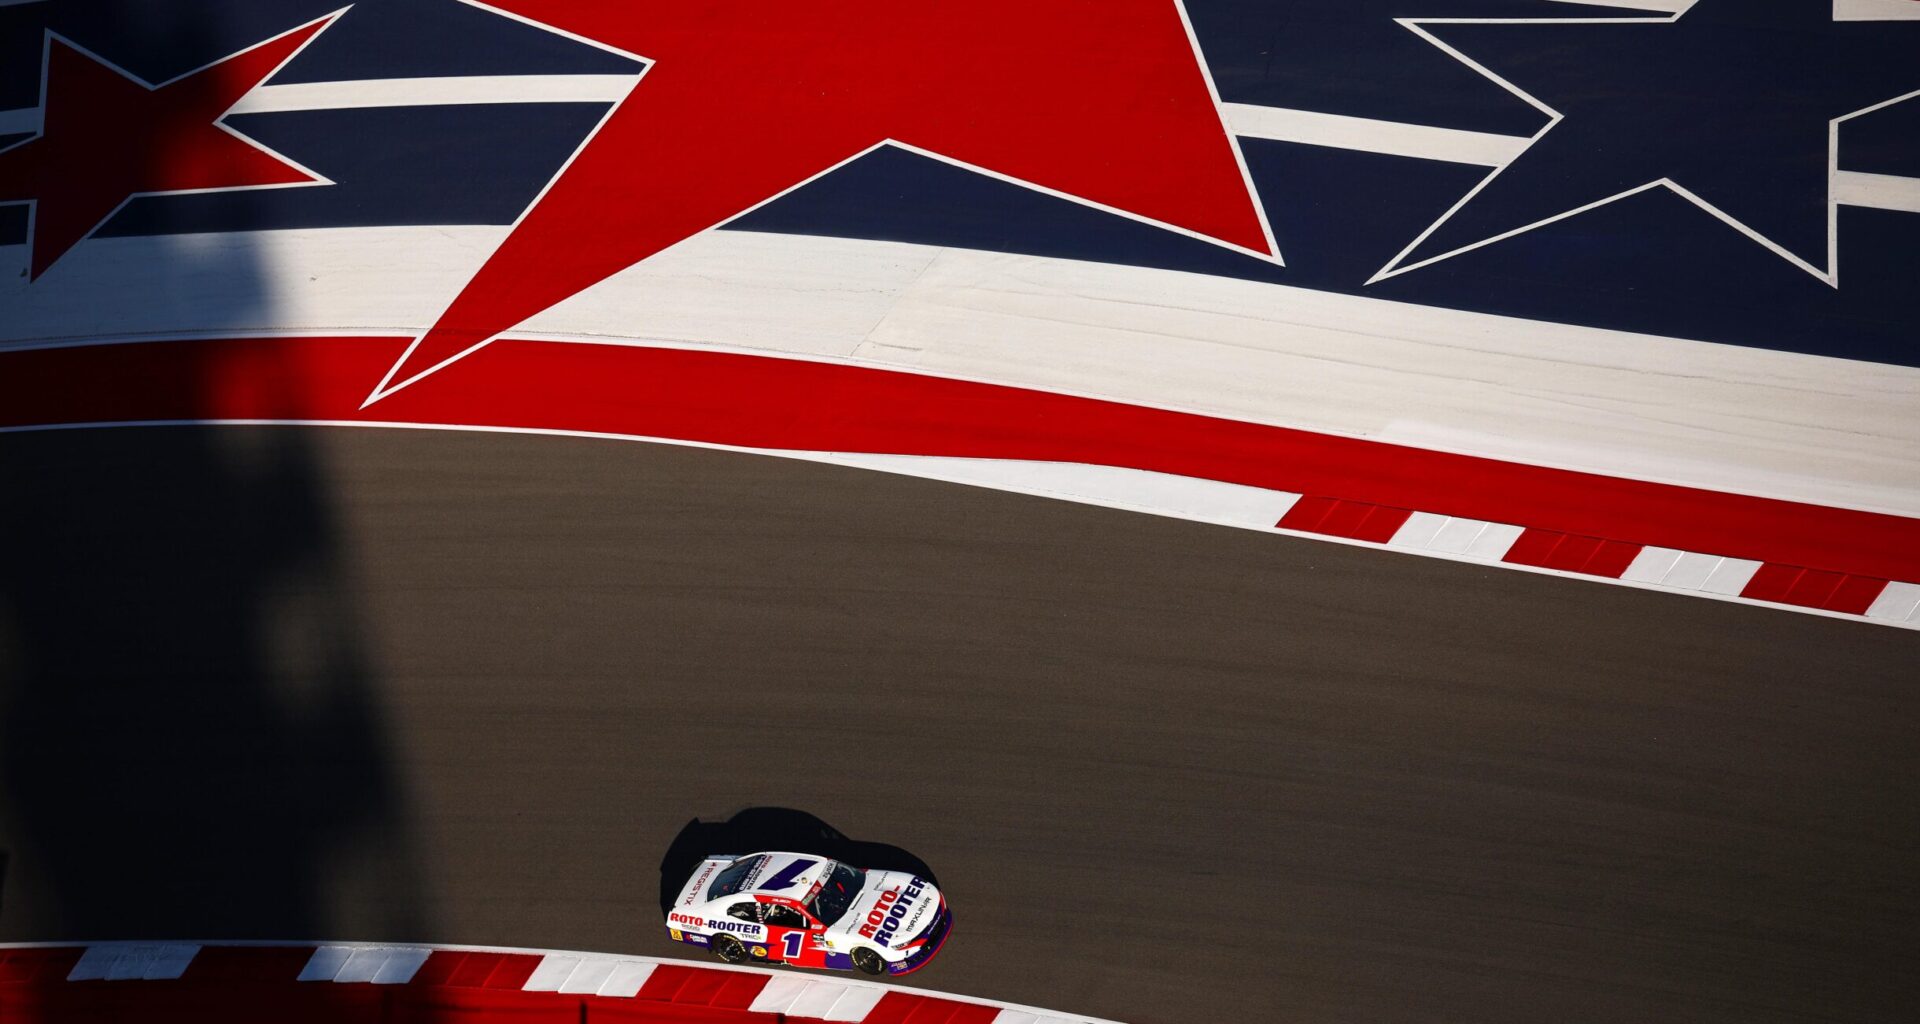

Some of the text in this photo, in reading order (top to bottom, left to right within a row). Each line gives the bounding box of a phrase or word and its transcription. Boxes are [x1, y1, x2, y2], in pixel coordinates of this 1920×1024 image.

[684, 867, 713, 905] REGISTIX
[757, 859, 818, 891] 1
[670, 912, 761, 934] ROTO-ROOTER
[858, 885, 900, 939] ROTO-
[873, 875, 928, 948] ROOTER
[781, 930, 805, 958] 1
